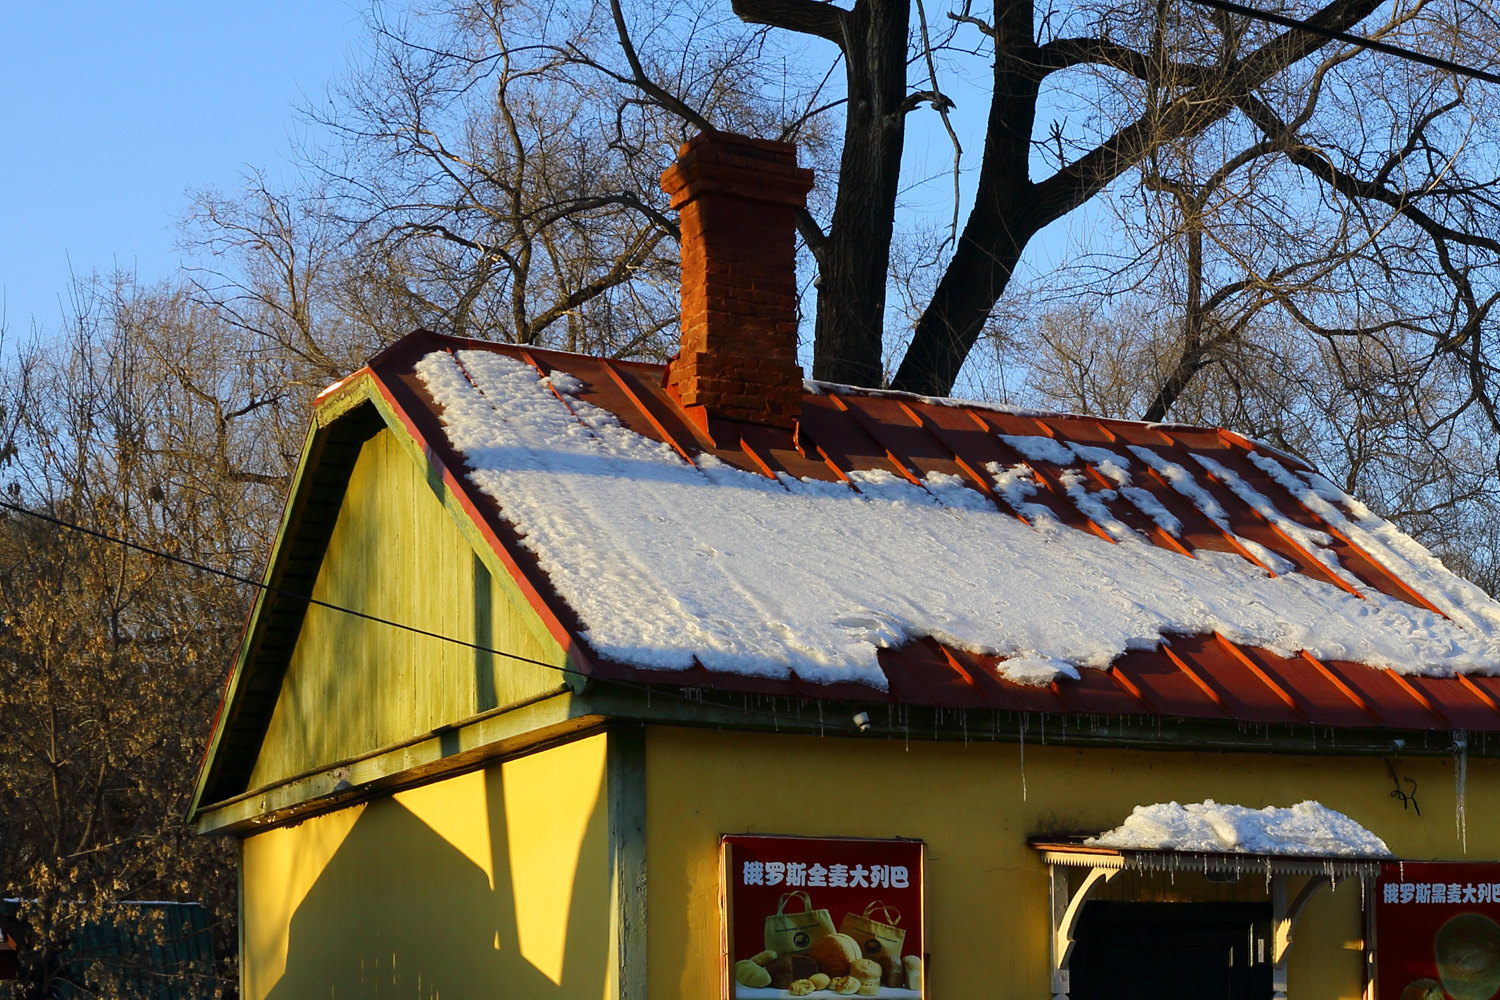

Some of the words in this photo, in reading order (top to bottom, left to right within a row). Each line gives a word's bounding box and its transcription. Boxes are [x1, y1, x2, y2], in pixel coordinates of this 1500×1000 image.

[743, 861, 909, 889] 俄罗斯全麦大列巴
